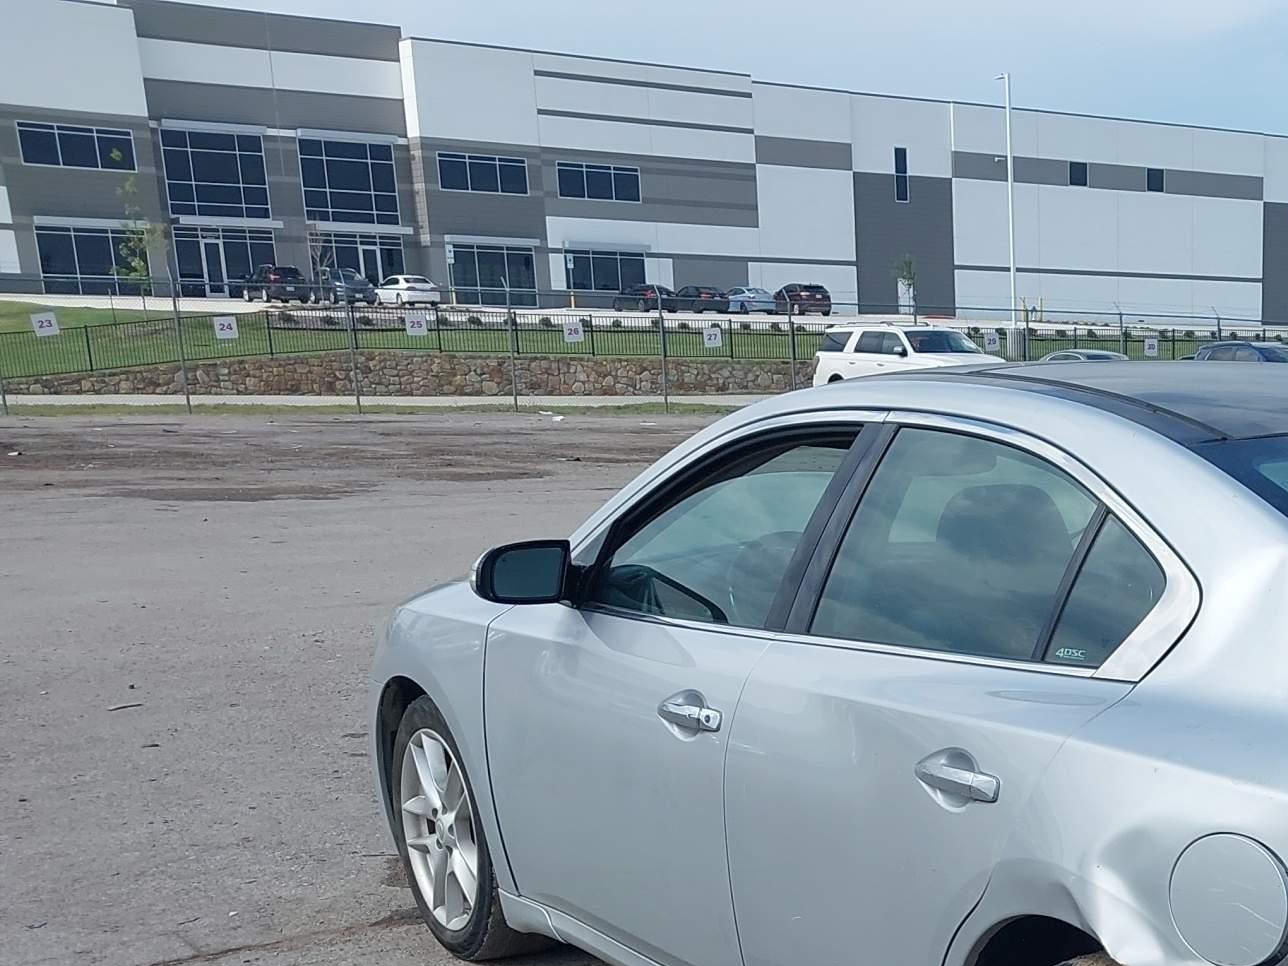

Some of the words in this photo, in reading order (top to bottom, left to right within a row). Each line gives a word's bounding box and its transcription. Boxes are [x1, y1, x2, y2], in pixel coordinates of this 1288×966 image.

[37, 319, 53, 329] 23
[218, 322, 233, 332] 24
[409, 319, 424, 330] 25
[567, 326, 580, 337] 26
[707, 332, 718, 342] 27
